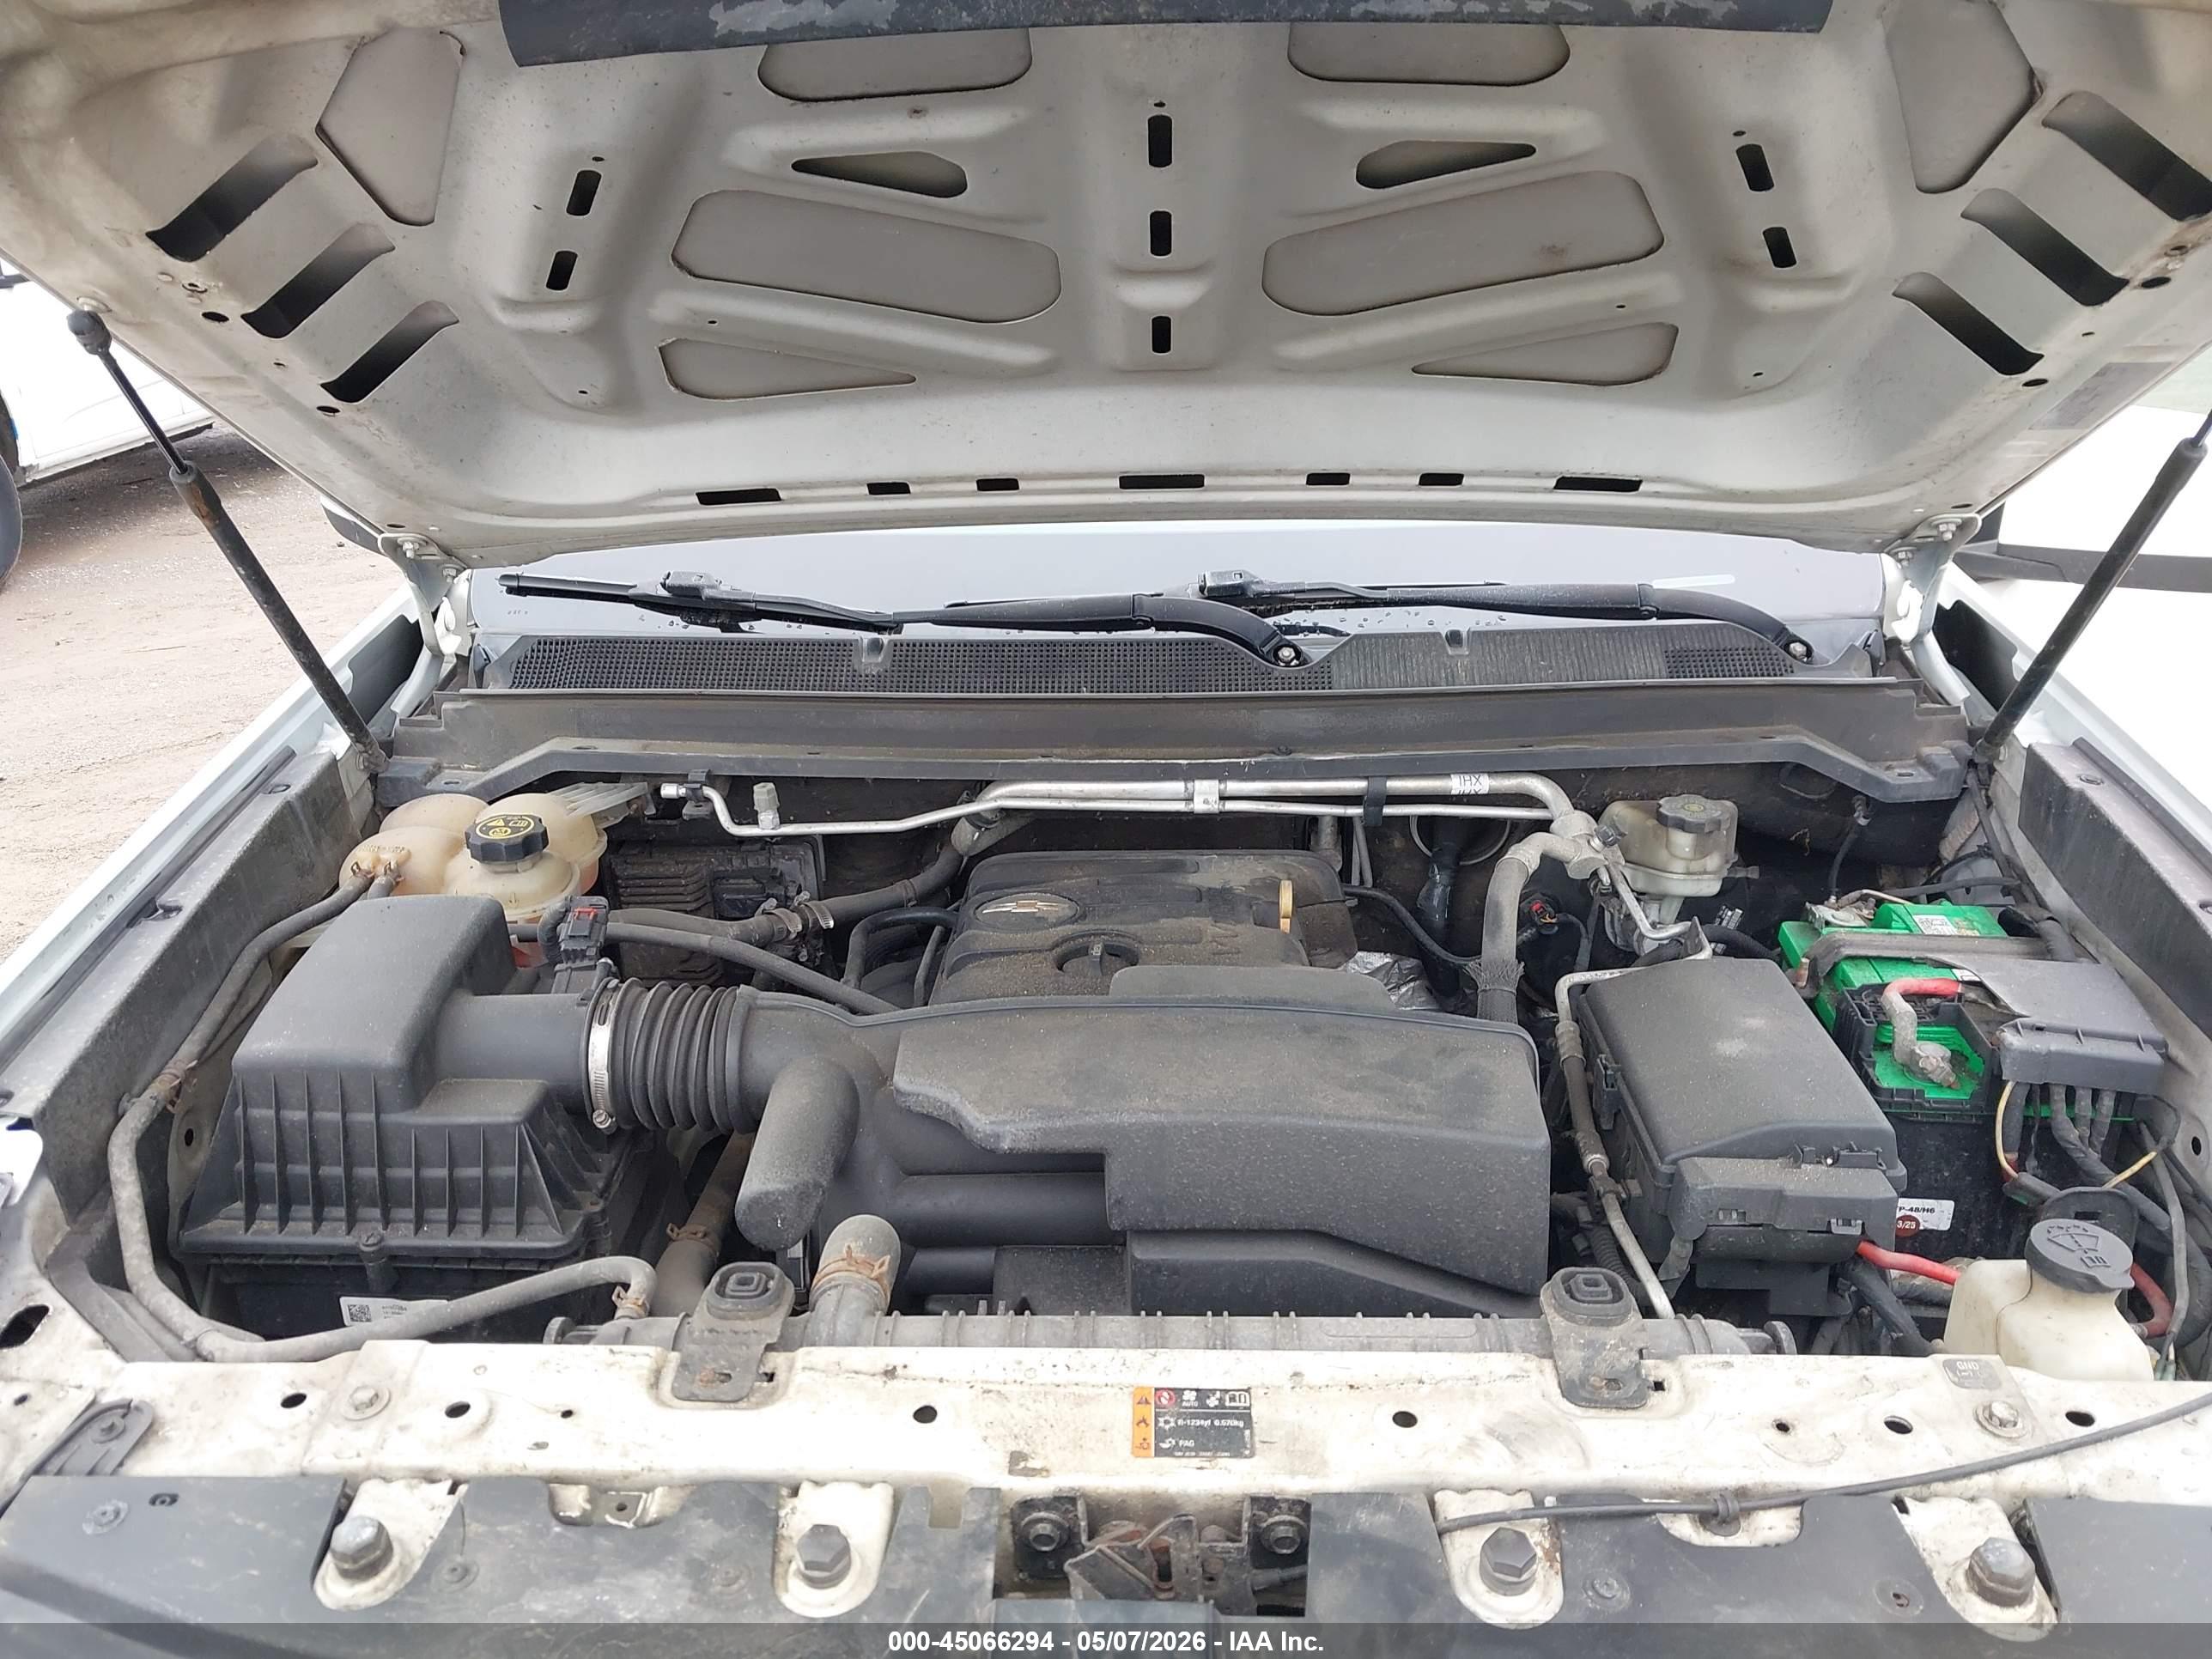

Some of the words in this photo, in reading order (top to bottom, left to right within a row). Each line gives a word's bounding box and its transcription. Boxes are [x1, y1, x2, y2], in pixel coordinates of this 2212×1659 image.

[1459, 775, 1482, 787] IHX
[1896, 1220, 1917, 1229] 3/25
[1956, 1360, 1979, 1370] GND
[1179, 1439, 1195, 1448] PAG
